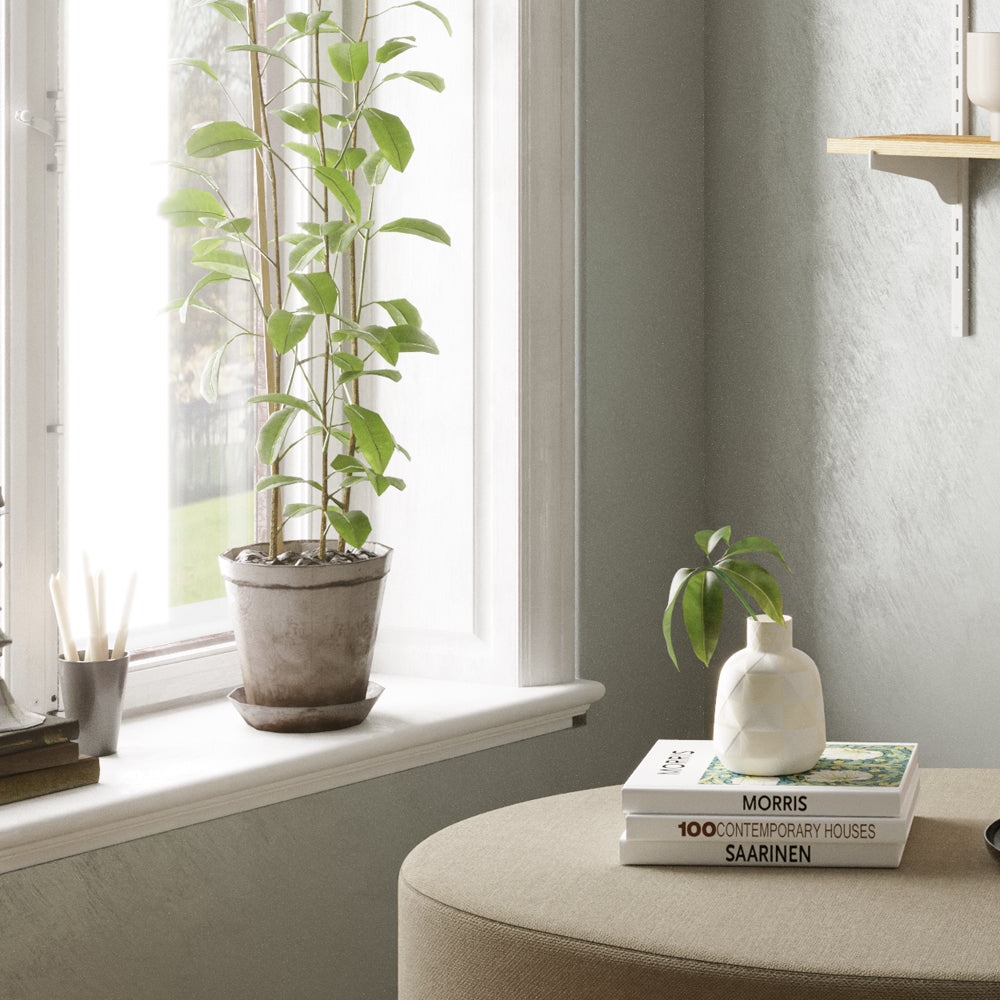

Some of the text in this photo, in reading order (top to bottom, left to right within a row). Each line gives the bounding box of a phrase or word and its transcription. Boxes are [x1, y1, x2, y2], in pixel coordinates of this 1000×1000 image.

[656, 750, 695, 775] MORRIS
[743, 795, 807, 811] MORRIS
[825, 823, 876, 839] HOUSES
[725, 844, 811, 863] SAARINEN
